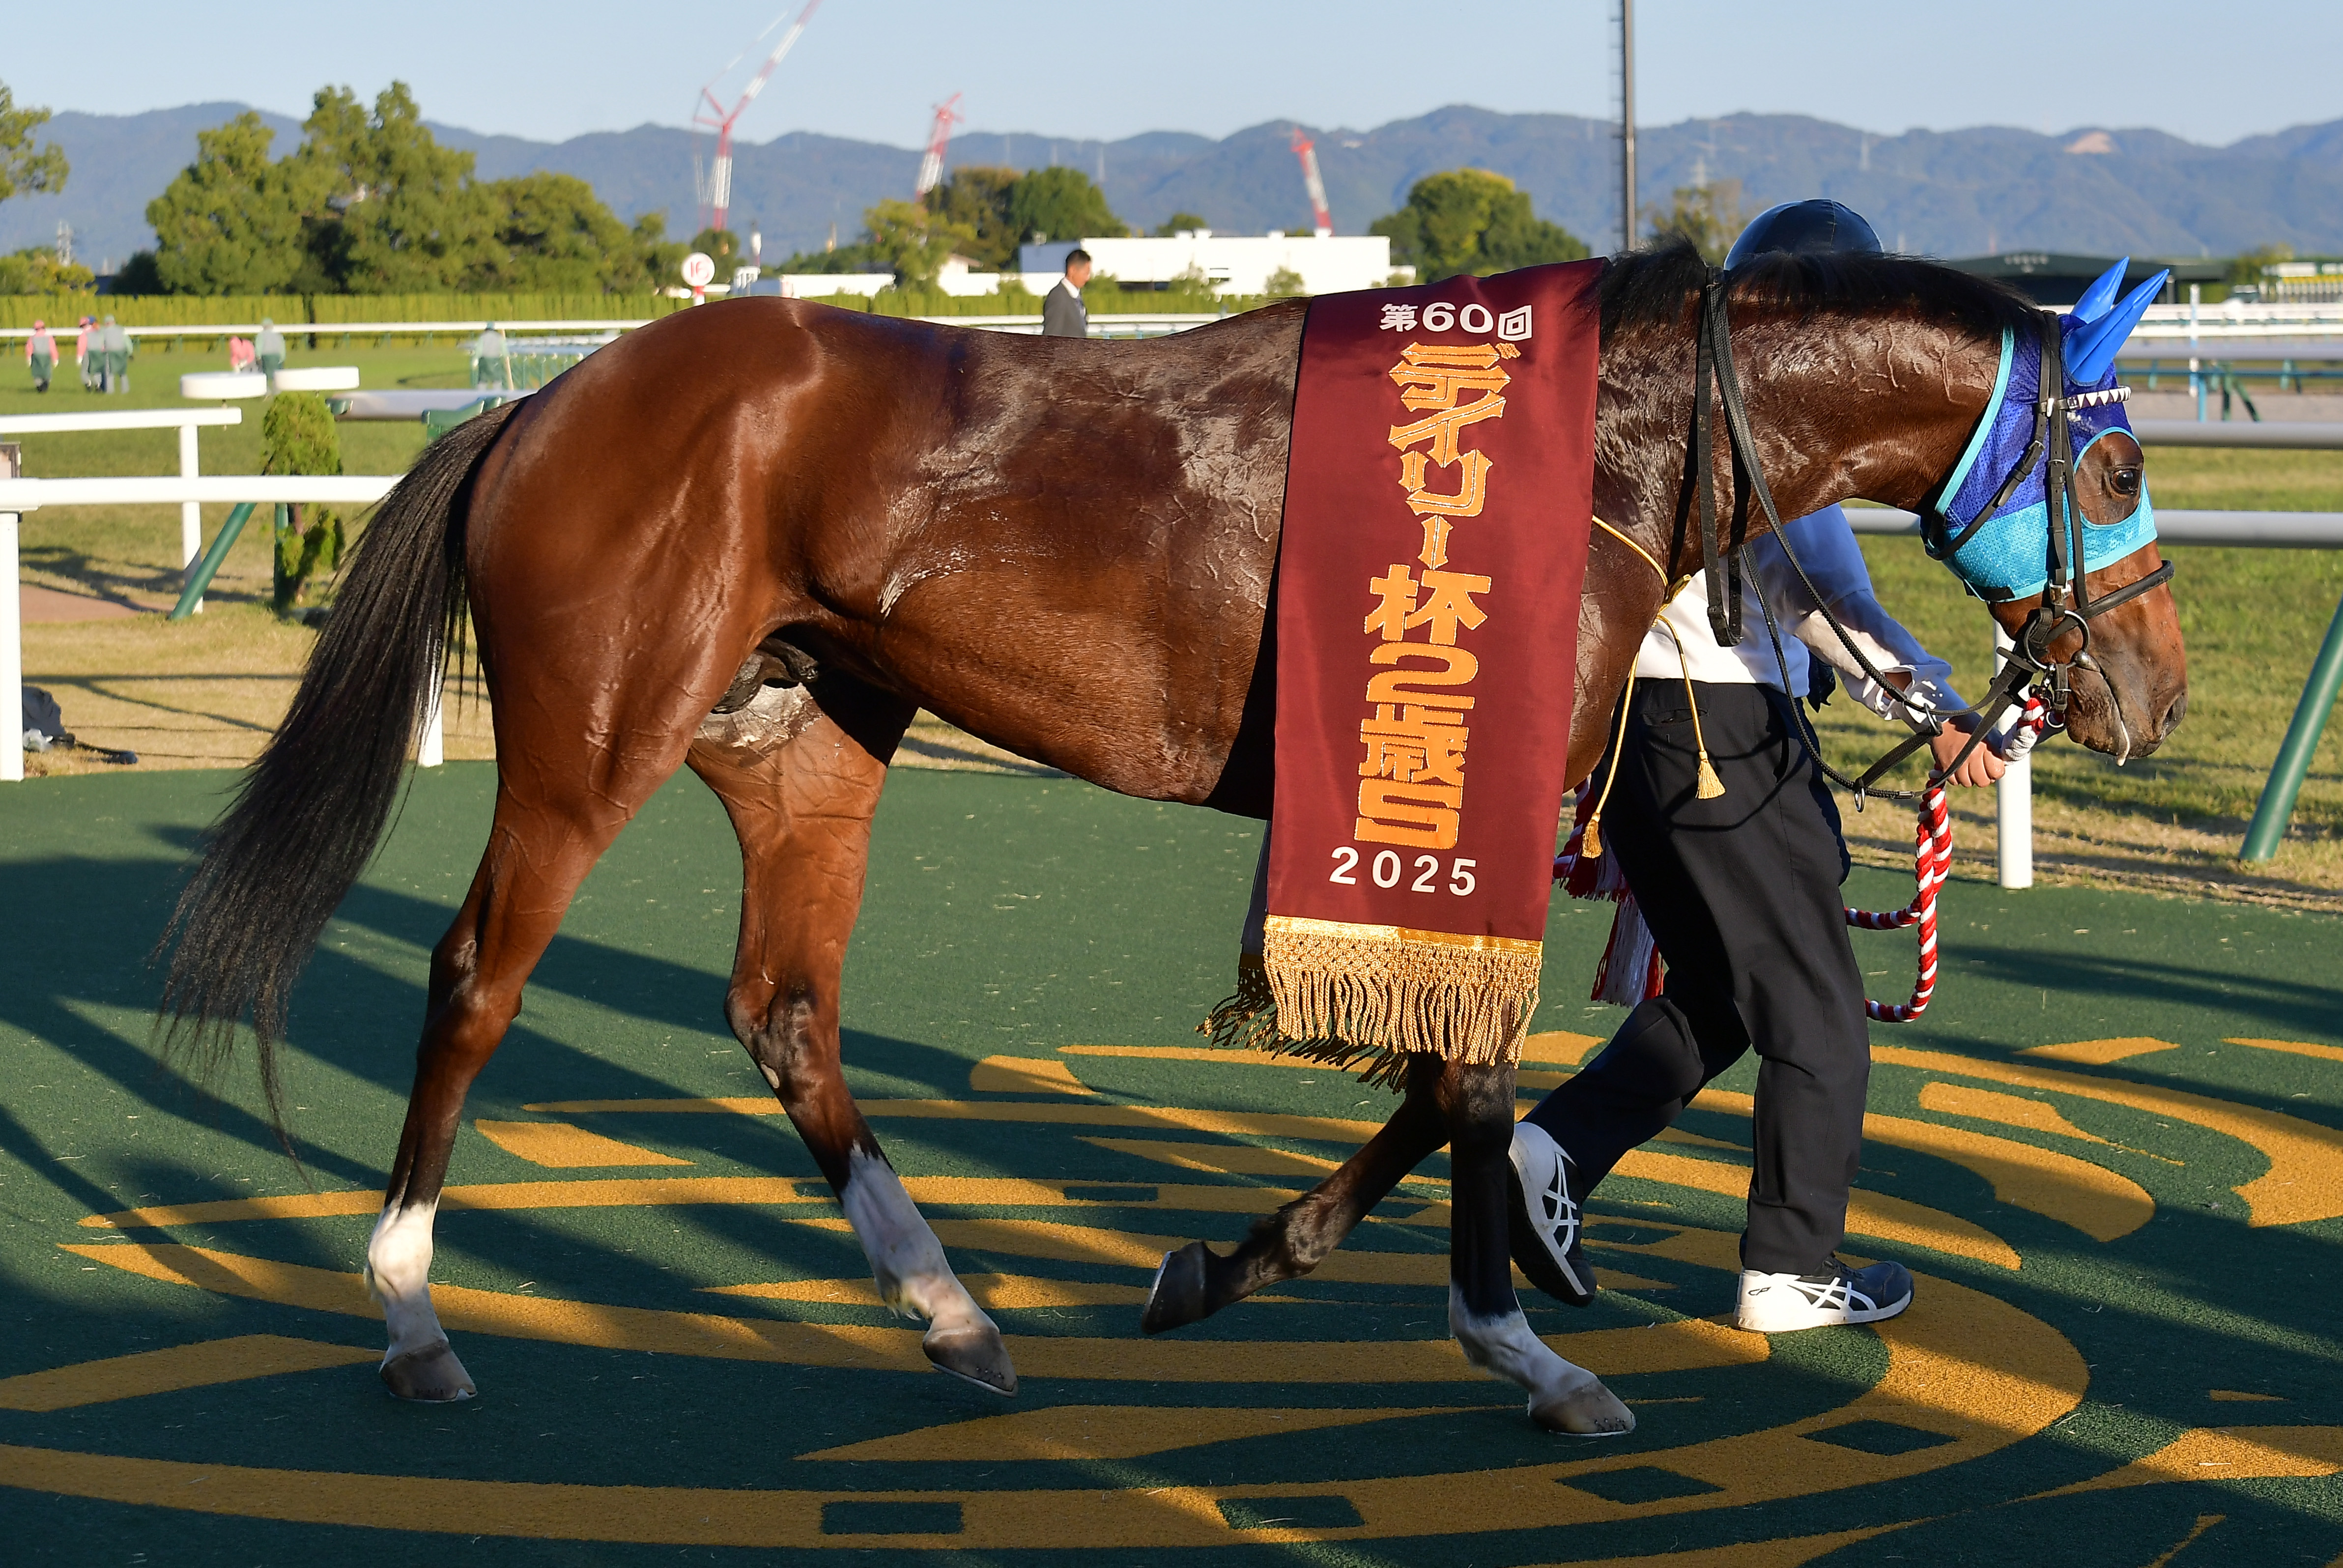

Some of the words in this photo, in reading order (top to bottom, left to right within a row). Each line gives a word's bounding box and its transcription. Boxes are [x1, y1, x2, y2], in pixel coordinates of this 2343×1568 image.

[690, 261, 709, 279] 16
[1379, 302, 1532, 341] 第60回
[1329, 846, 1477, 896] 2025
